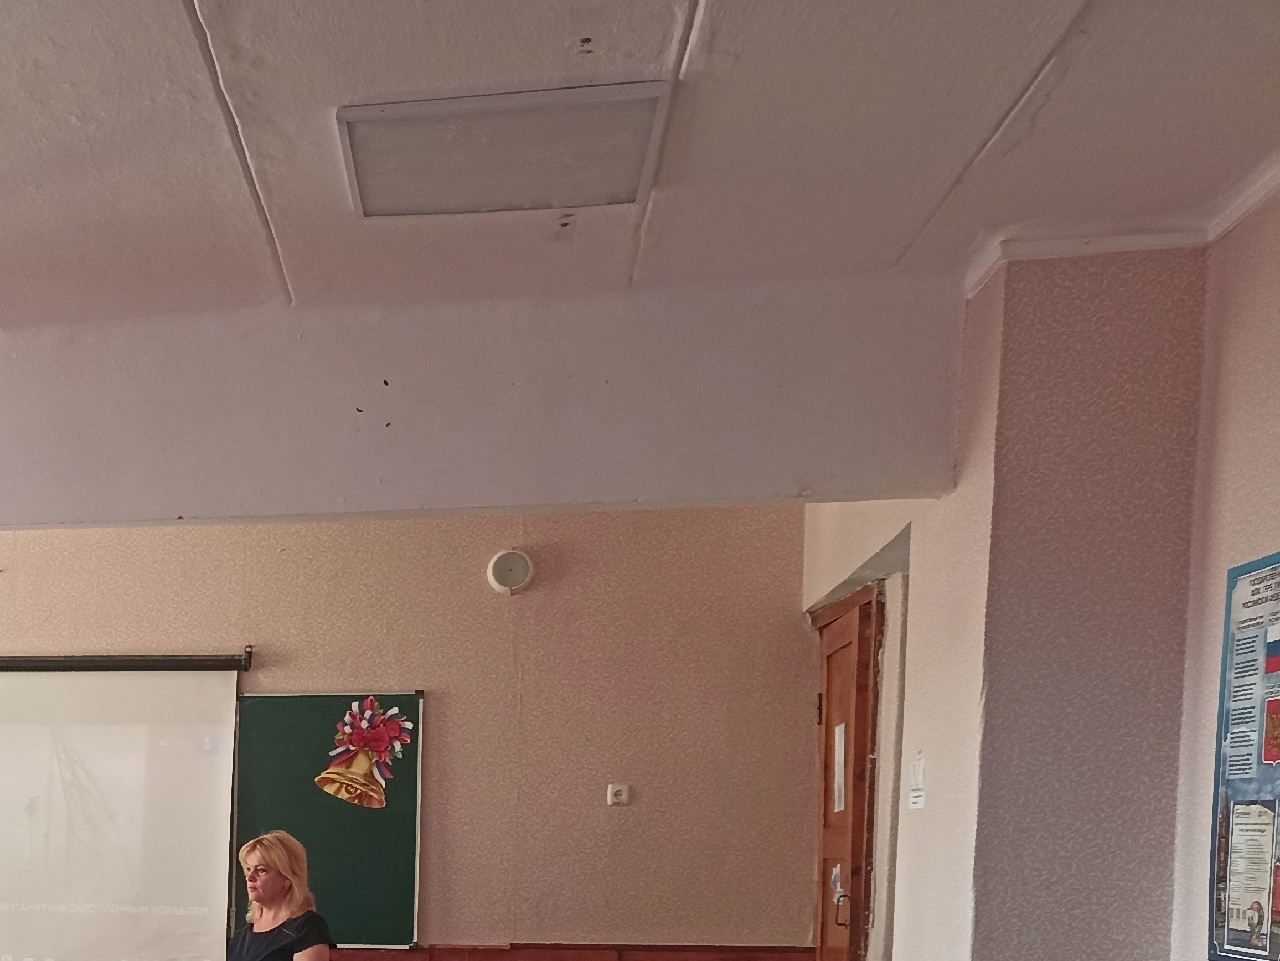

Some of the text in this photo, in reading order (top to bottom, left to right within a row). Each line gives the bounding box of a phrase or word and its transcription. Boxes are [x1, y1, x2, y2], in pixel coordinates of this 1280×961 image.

[11, 902, 68, 912] ПАМЯТНИК
[69, 903, 149, 914] ЗАТОПЛЕННЫМ
[151, 905, 209, 915] КОРАБЛЯМ
